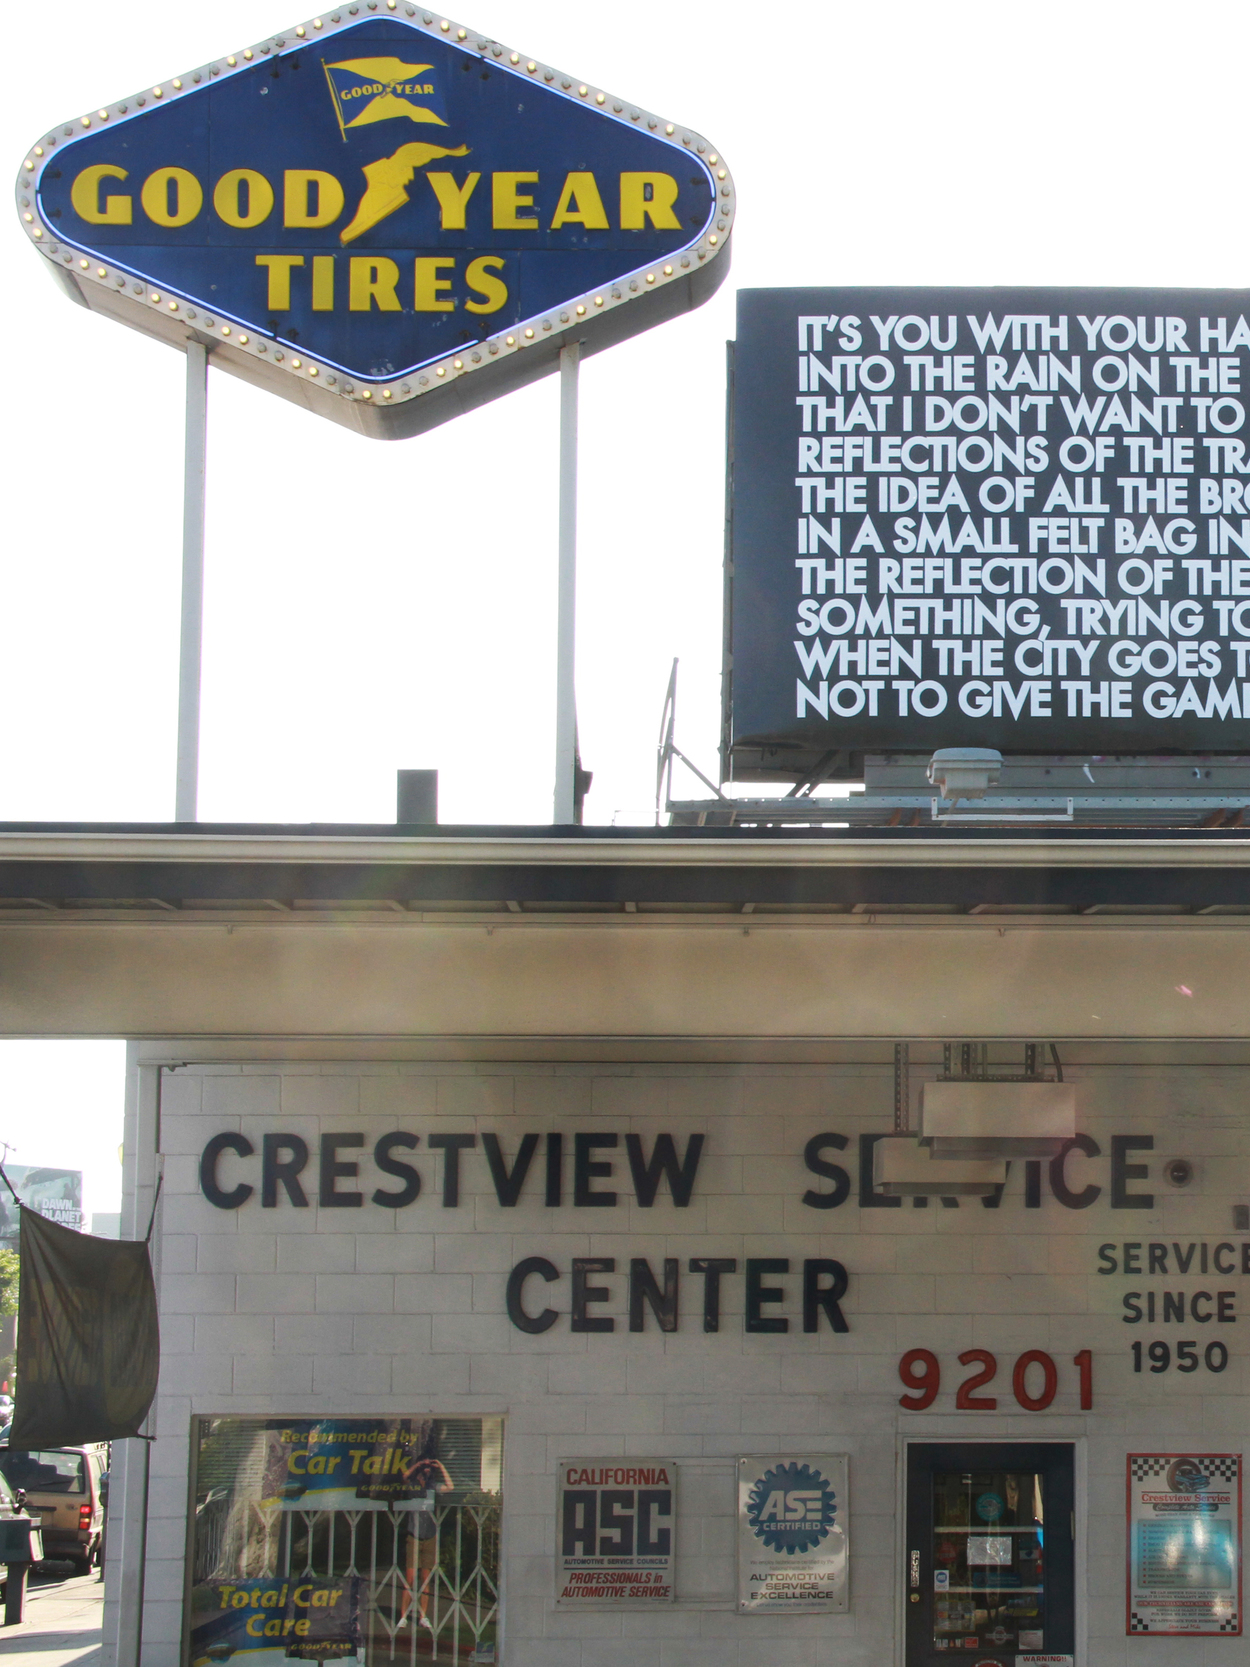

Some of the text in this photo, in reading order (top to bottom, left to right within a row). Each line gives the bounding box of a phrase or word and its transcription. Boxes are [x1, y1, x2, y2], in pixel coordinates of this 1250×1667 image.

[341, 82, 435, 101] GOOD YEAR
[255, 254, 510, 315] TIRES
[797, 314, 863, 350] IT'S
[868, 315, 958, 351] YOU
[966, 315, 1069, 351] WITH
[1076, 316, 1191, 352] YOUR
[798, 355, 896, 391] INTO
[902, 355, 976, 392] THE
[986, 356, 1081, 392] RAIN
[1091, 356, 1160, 392] ON
[1168, 356, 1241, 393] THE
[798, 436, 1050, 473] REFLECTIONS
[1058, 436, 1116, 473] OF
[1122, 436, 1195, 474] THE
[794, 476, 867, 513] THE
[878, 476, 971, 513] IDEA
[978, 477, 1035, 513] OF
[1042, 477, 1110, 514] ALL
[1116, 477, 1189, 514] THE
[797, 519, 841, 553] IN
[850, 518, 885, 553] A
[892, 518, 1019, 553] SMALL
[1028, 518, 1105, 554] FELT
[1114, 518, 1198, 554] BAG
[1208, 518, 1250, 555] IN
[793, 639, 922, 676] WHEN
[931, 639, 1004, 676] THE
[1014, 639, 1101, 676] CITY
[1107, 640, 1222, 677] GOES
[796, 680, 885, 717] NOT
[891, 680, 948, 717] TO
[957, 680, 1052, 718] GIVE
[1060, 681, 1133, 718] THE
[199, 1132, 706, 1210] CRESTVIEW
[506, 1256, 850, 1335] CENTER
[1122, 1291, 1237, 1324] SINCE
[1130, 1340, 1229, 1375] 1950
[898, 1348, 1093, 1412] 9201
[281, 1429, 419, 1447] Recommended by
[287, 1448, 411, 1475] Car Talk
[566, 1468, 670, 1485] CALIFORNIA
[758, 1490, 823, 1521] ASE
[1141, 1493, 1231, 1503] Crestview Service
[562, 1489, 672, 1556] ASC
[763, 1522, 822, 1531] CERTIFIED
[561, 1585, 672, 1598] AUTOMOTIVE SERVICE
[568, 1572, 653, 1585] PROFESSIONALS
[750, 1572, 836, 1582] AUTOMOTIVE
[765, 1582, 820, 1591] SERVICE
[218, 1583, 343, 1609] Total Car
[750, 1591, 834, 1600] EXCELLENCE
[245, 1613, 312, 1637] Care
